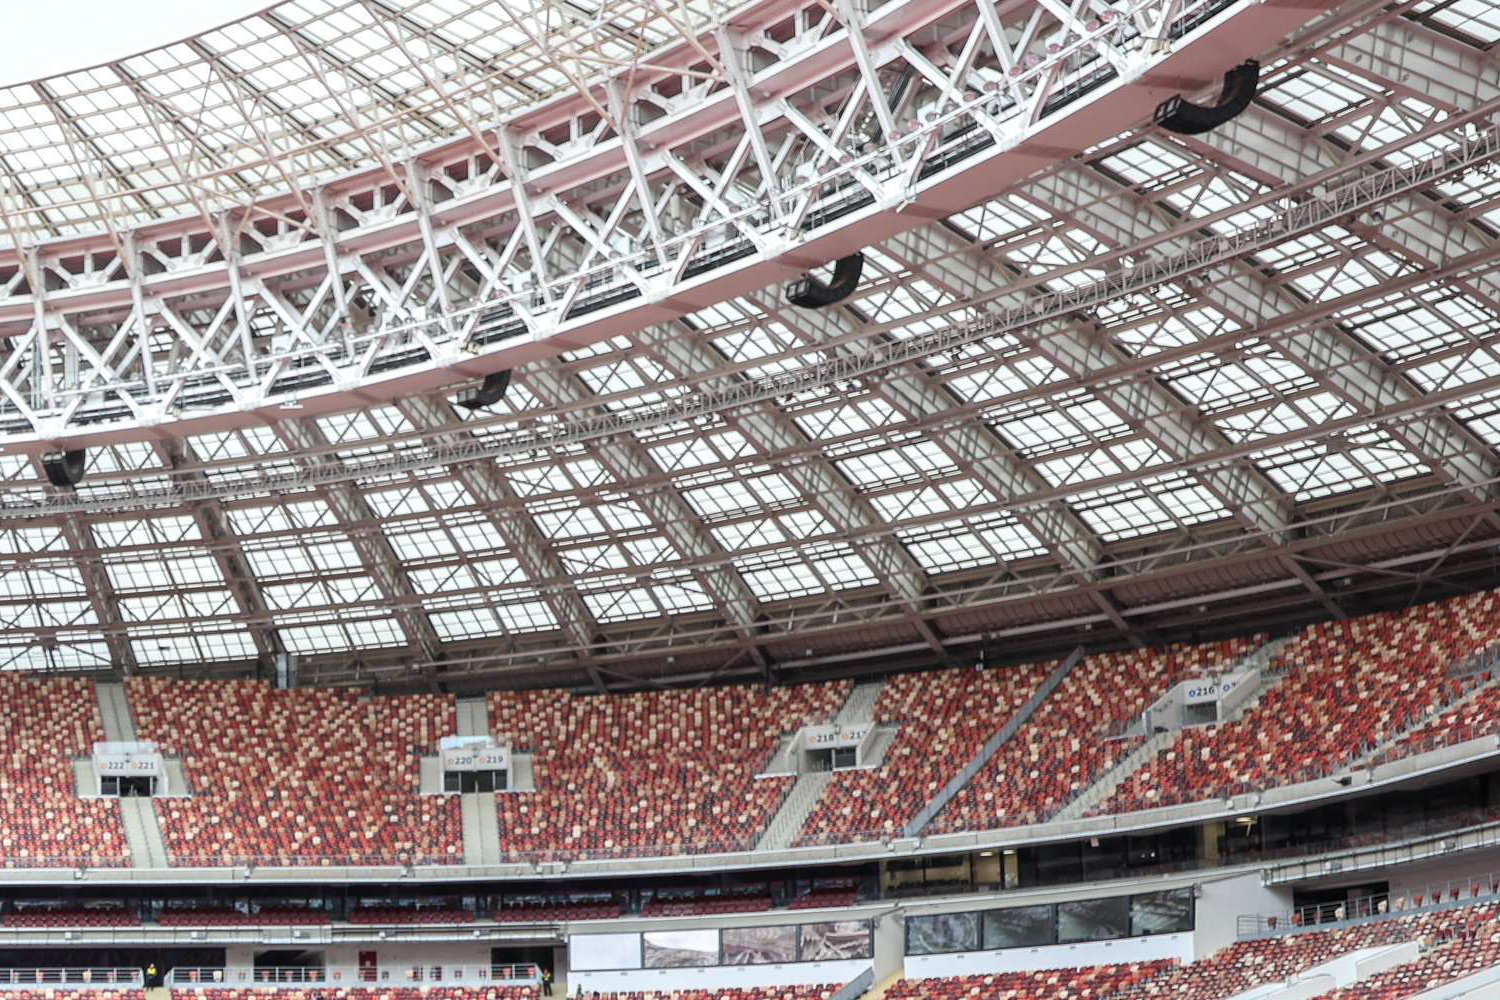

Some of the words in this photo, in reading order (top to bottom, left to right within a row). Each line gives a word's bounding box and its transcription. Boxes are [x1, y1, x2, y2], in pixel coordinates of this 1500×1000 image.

[1197, 686, 1215, 697] 216
[455, 757, 472, 765] 220
[487, 756, 503, 764] 219
[108, 762, 125, 770] 222
[138, 762, 155, 770] 221
